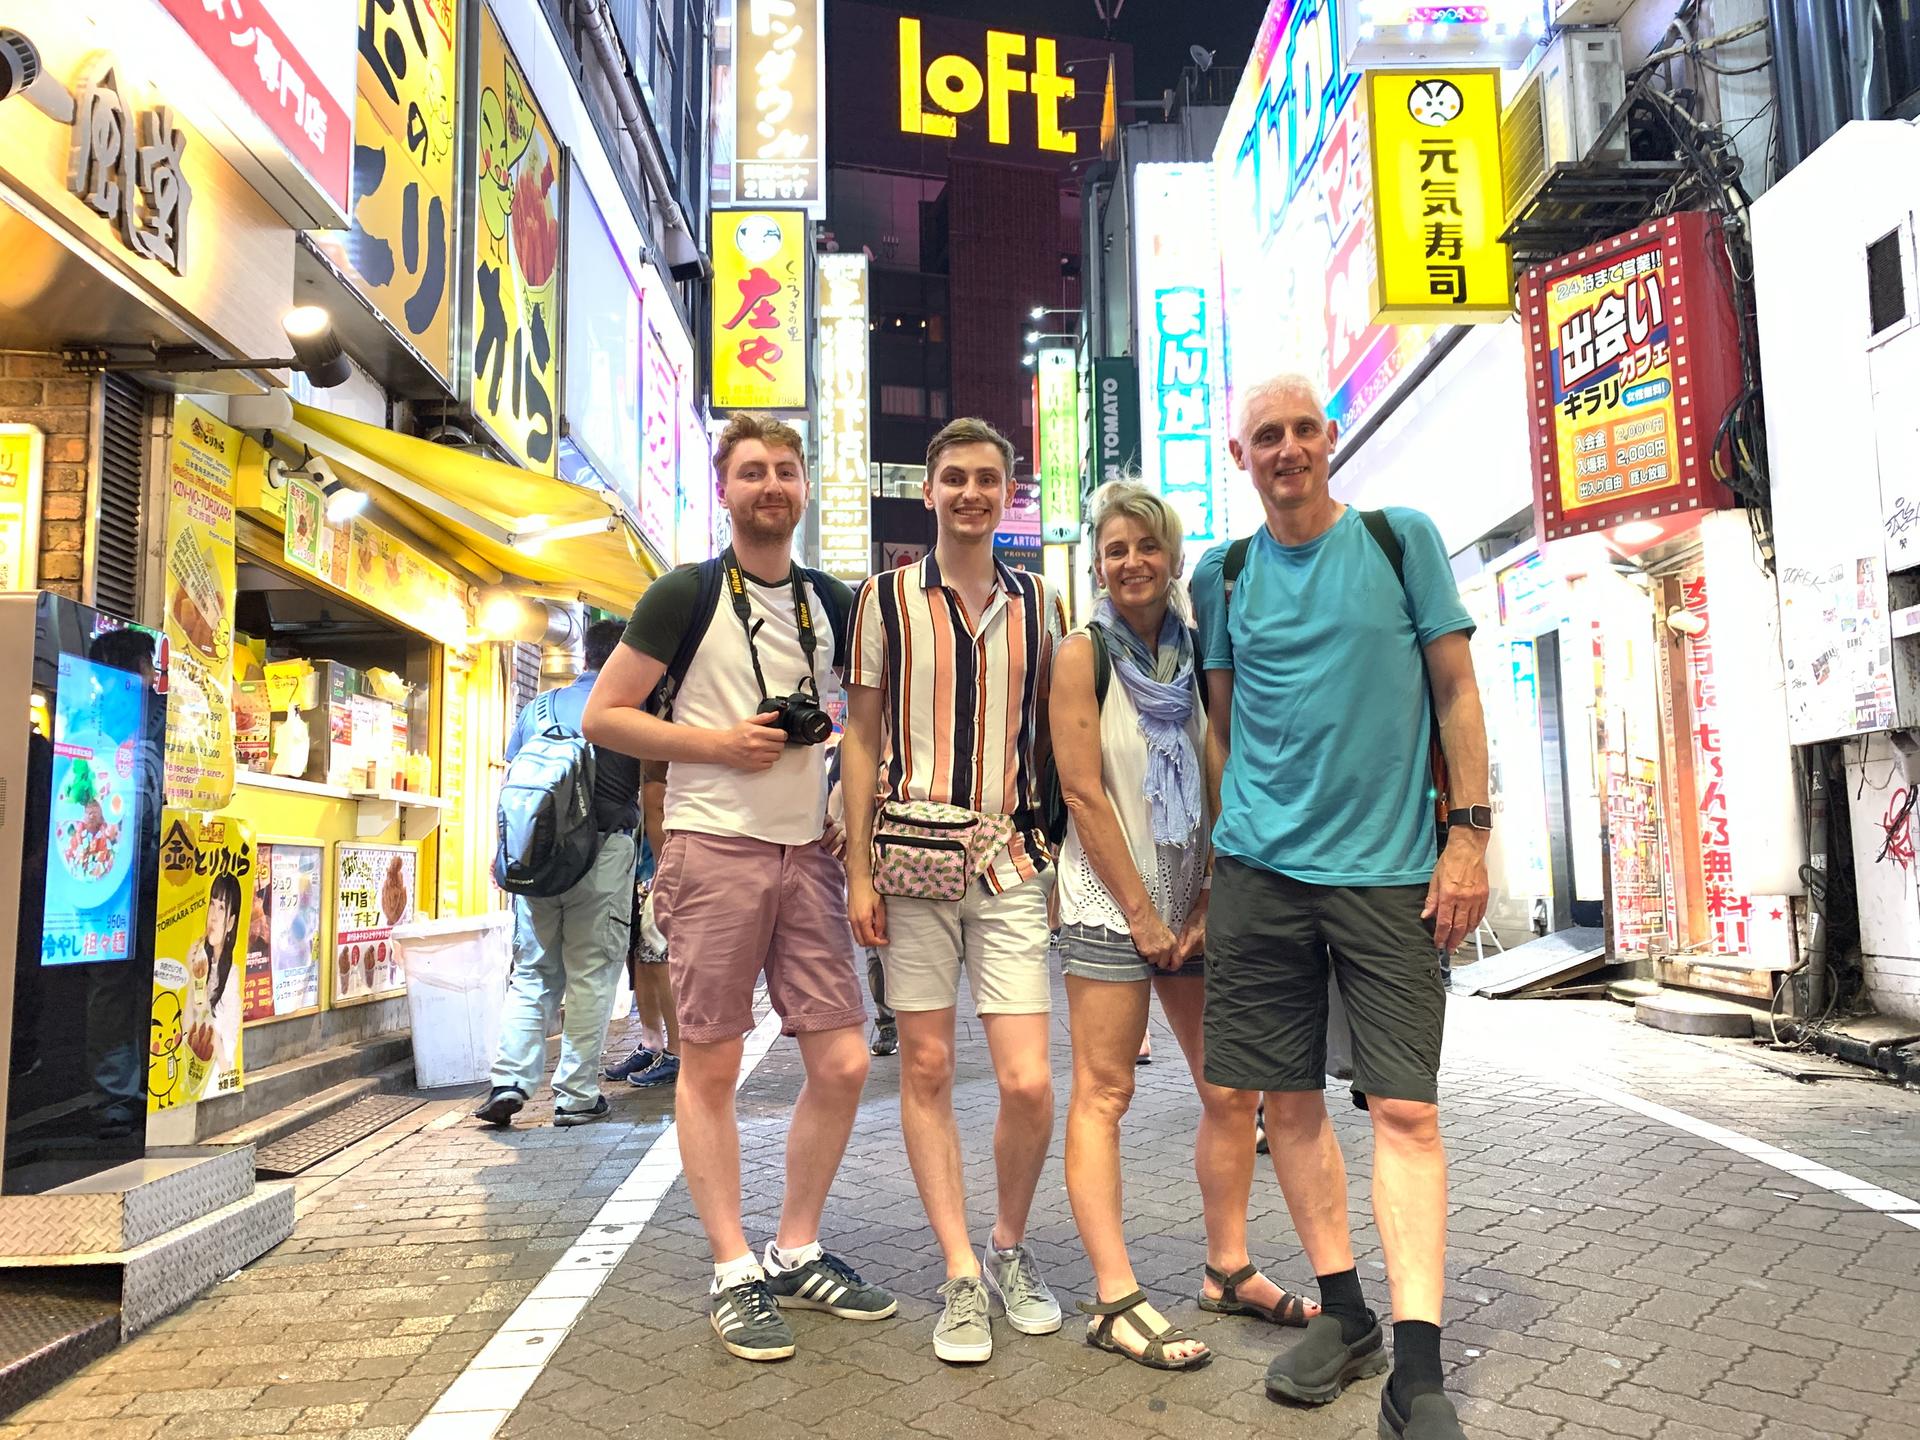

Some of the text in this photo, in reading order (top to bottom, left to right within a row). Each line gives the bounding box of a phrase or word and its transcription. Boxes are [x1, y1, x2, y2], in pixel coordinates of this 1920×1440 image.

[1419, 138, 1468, 304] 元気寿司
[722, 267, 783, 382] 庄や
[1560, 275, 1663, 388] 出会い
[1619, 341, 1670, 389] カフェ
[1103, 377, 1120, 457] TOMATO
[1564, 379, 1621, 420] キラリ
[1616, 438, 1666, 466] 2,000円
[729, 567, 744, 595] Nikon
[801, 602, 811, 629] Nikon
[157, 898, 207, 932] TORIKARA STICK
